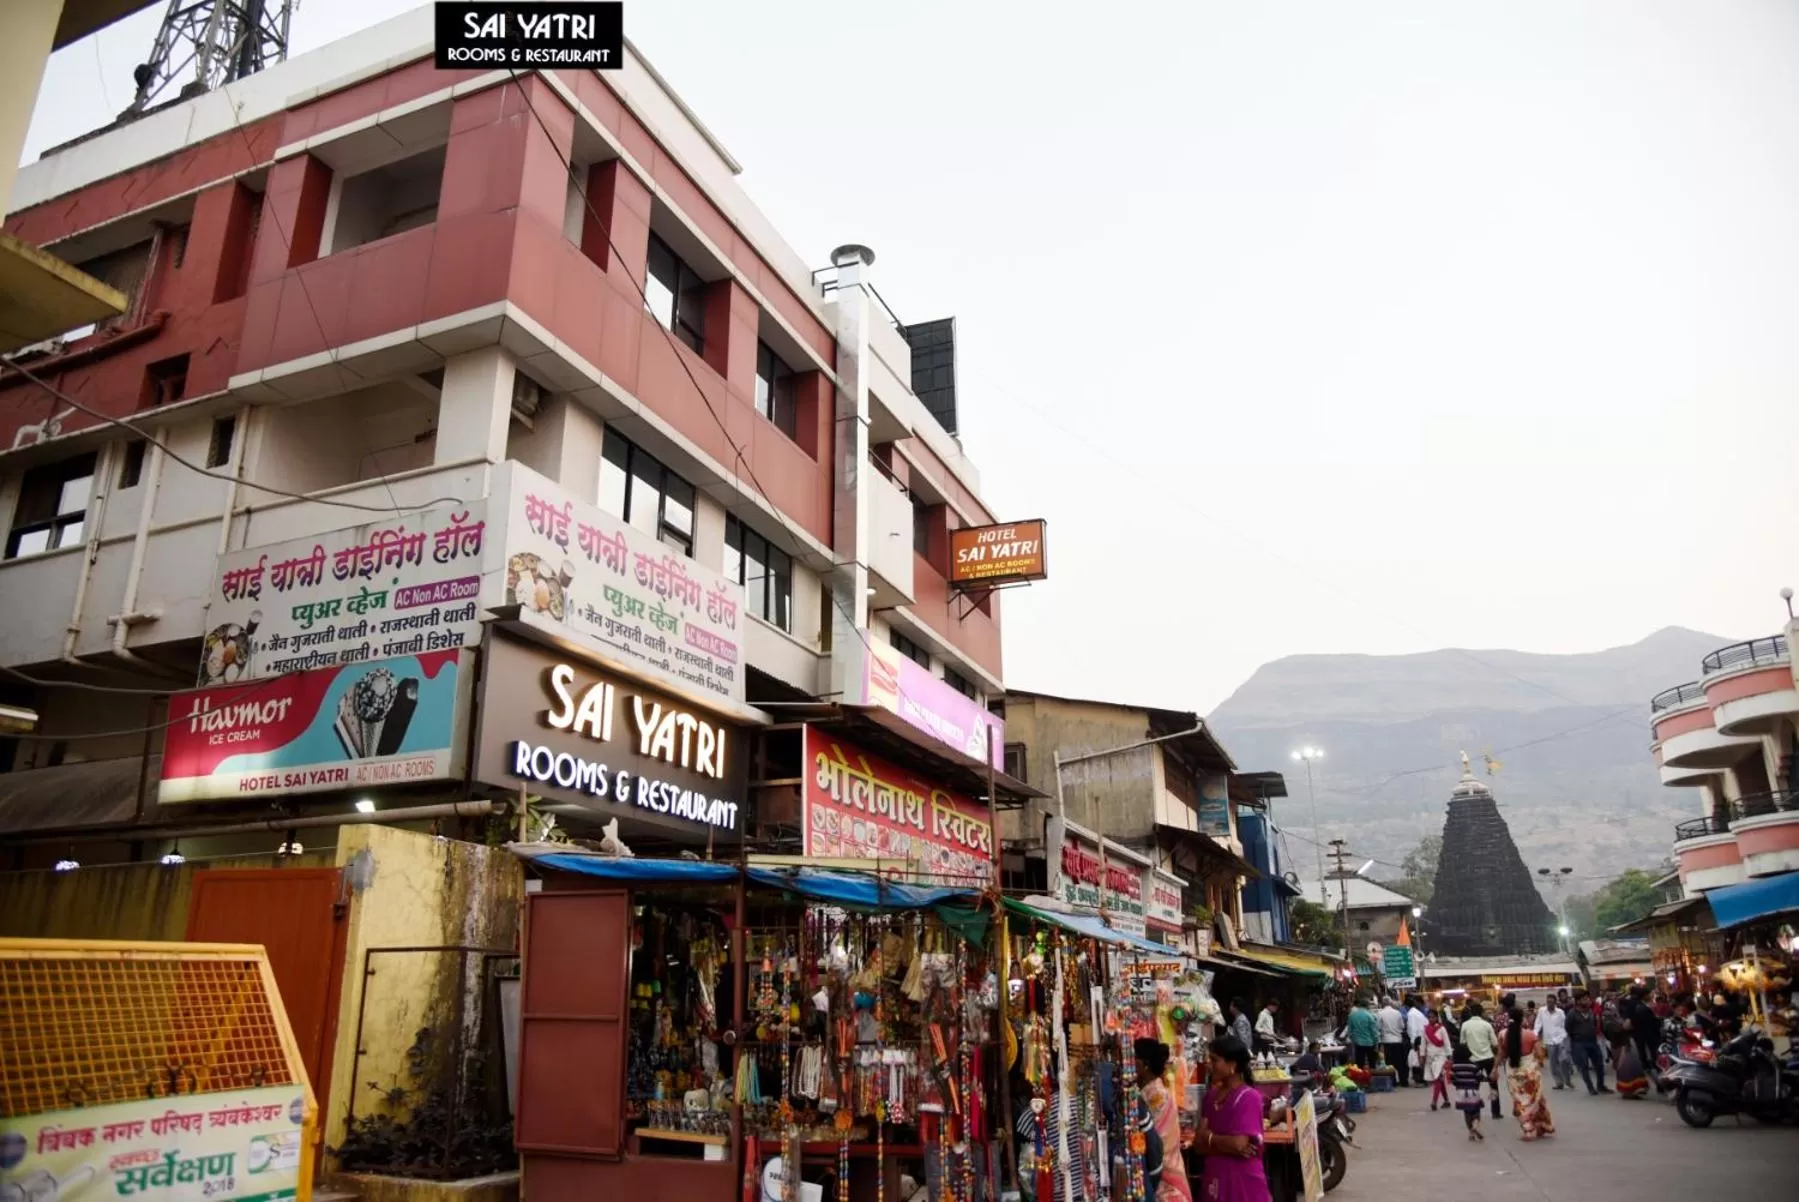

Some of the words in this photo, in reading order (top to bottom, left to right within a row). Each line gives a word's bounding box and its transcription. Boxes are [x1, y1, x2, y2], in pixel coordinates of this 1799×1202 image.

[957, 546, 986, 563] SAI
[991, 540, 1039, 559] YATRI
[978, 529, 1017, 543] HOTEL
[222, 554, 268, 603] साई
[271, 545, 326, 592] यात्री
[332, 527, 426, 580] डाईनिंग
[433, 511, 485, 563] हॉल
[525, 493, 573, 555] साई
[577, 521, 629, 577] यात्री
[707, 579, 738, 631] हॉल
[396, 592, 410, 608] AC
[412, 588, 432, 603] Non
[434, 584, 448, 599] AC
[450, 578, 479, 596] Room
[290, 625, 335, 653] गुजराती
[337, 620, 367, 641] थाली
[380, 608, 440, 634] राजस्थानी
[443, 601, 476, 624] थाली
[291, 597, 342, 629] प्युअर
[188, 697, 292, 734] Havmor
[548, 664, 614, 742] SAI
[634, 695, 725, 779] YATRI
[209, 734, 225, 745] ICE
[227, 729, 261, 743] CREAM
[239, 775, 281, 792] HOTEL
[285, 773, 307, 788] SAI
[309, 768, 349, 785] YATRI
[515, 740, 608, 796] ROOMS
[615, 770, 630, 802] &
[637, 776, 738, 829] RESTAURANT
[815, 743, 926, 831] भोलेनाथ
[103, 1120, 145, 1143] नगर
[115, 1149, 237, 1196] सर्वेक्षण
